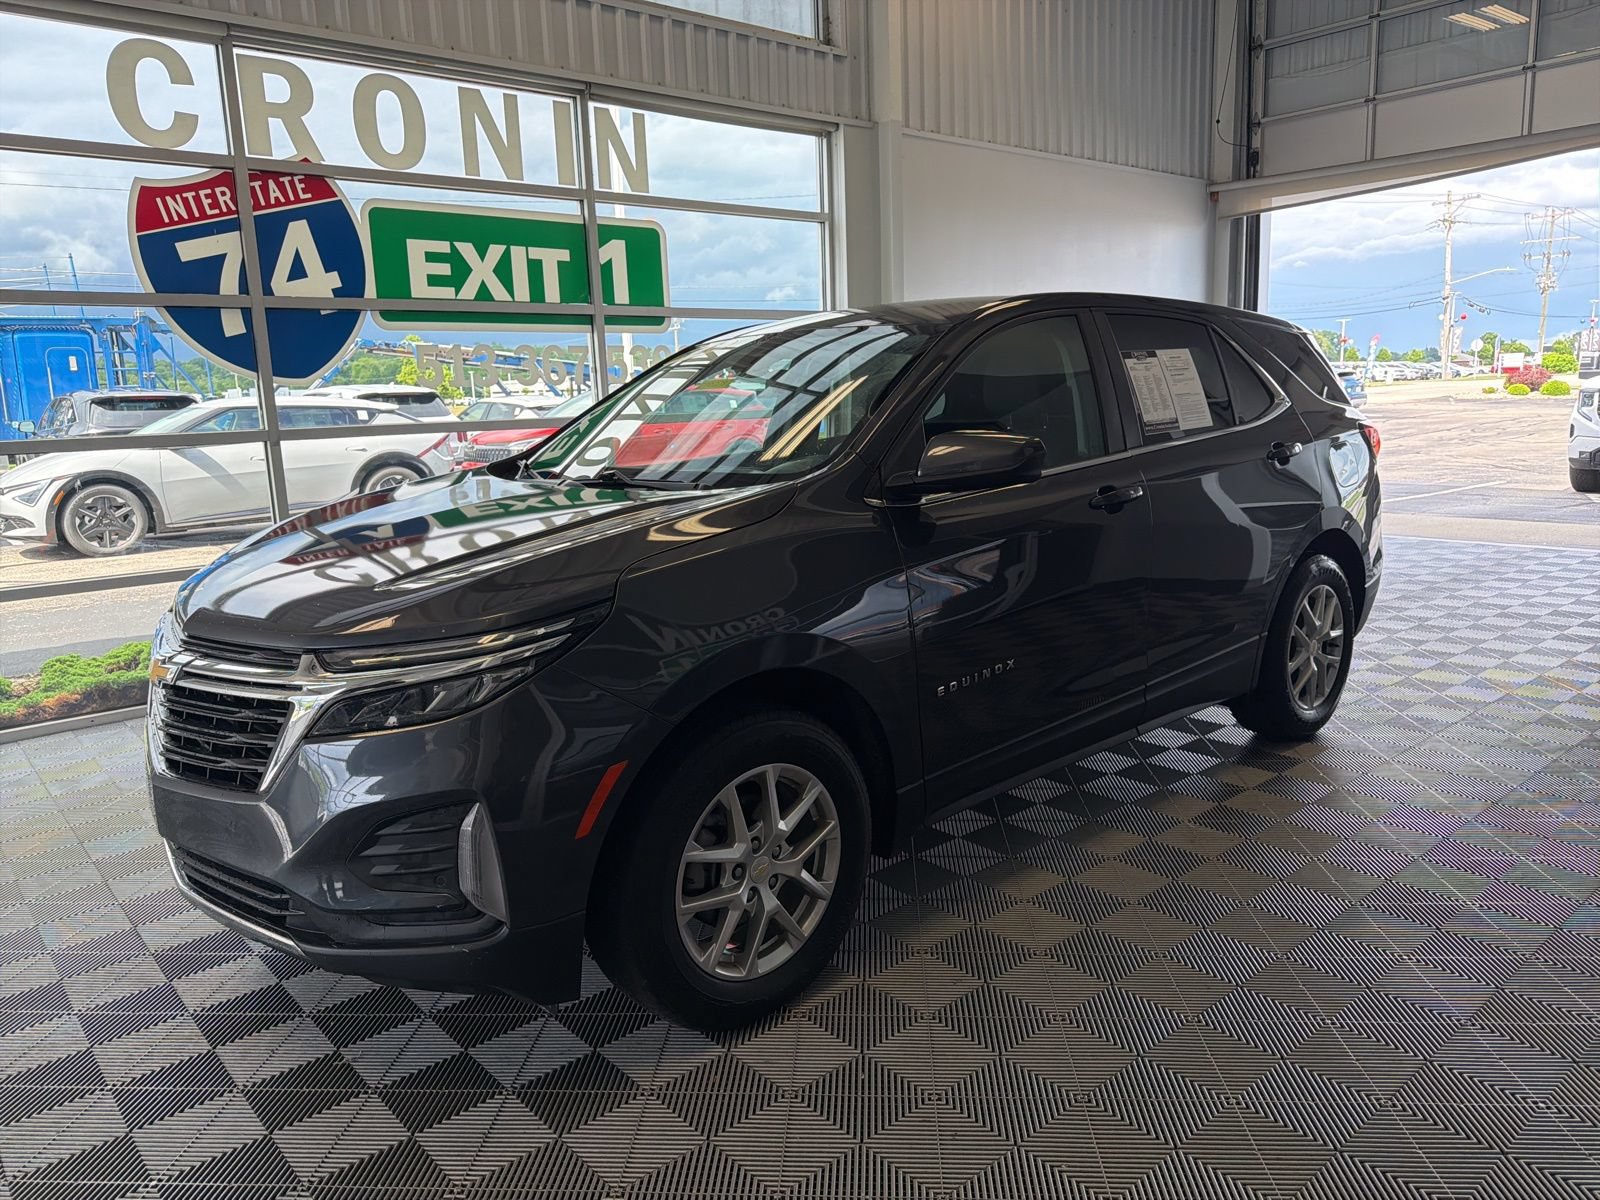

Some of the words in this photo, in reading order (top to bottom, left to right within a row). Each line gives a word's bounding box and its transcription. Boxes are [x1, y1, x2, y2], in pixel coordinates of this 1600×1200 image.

[106, 38, 650, 195] CRONIN
[156, 175, 313, 224] INTERTATE
[174, 219, 343, 338] 74
[406, 238, 571, 304] EXIT
[598, 239, 630, 305] 1
[937, 659, 1015, 697] EQUINOX
